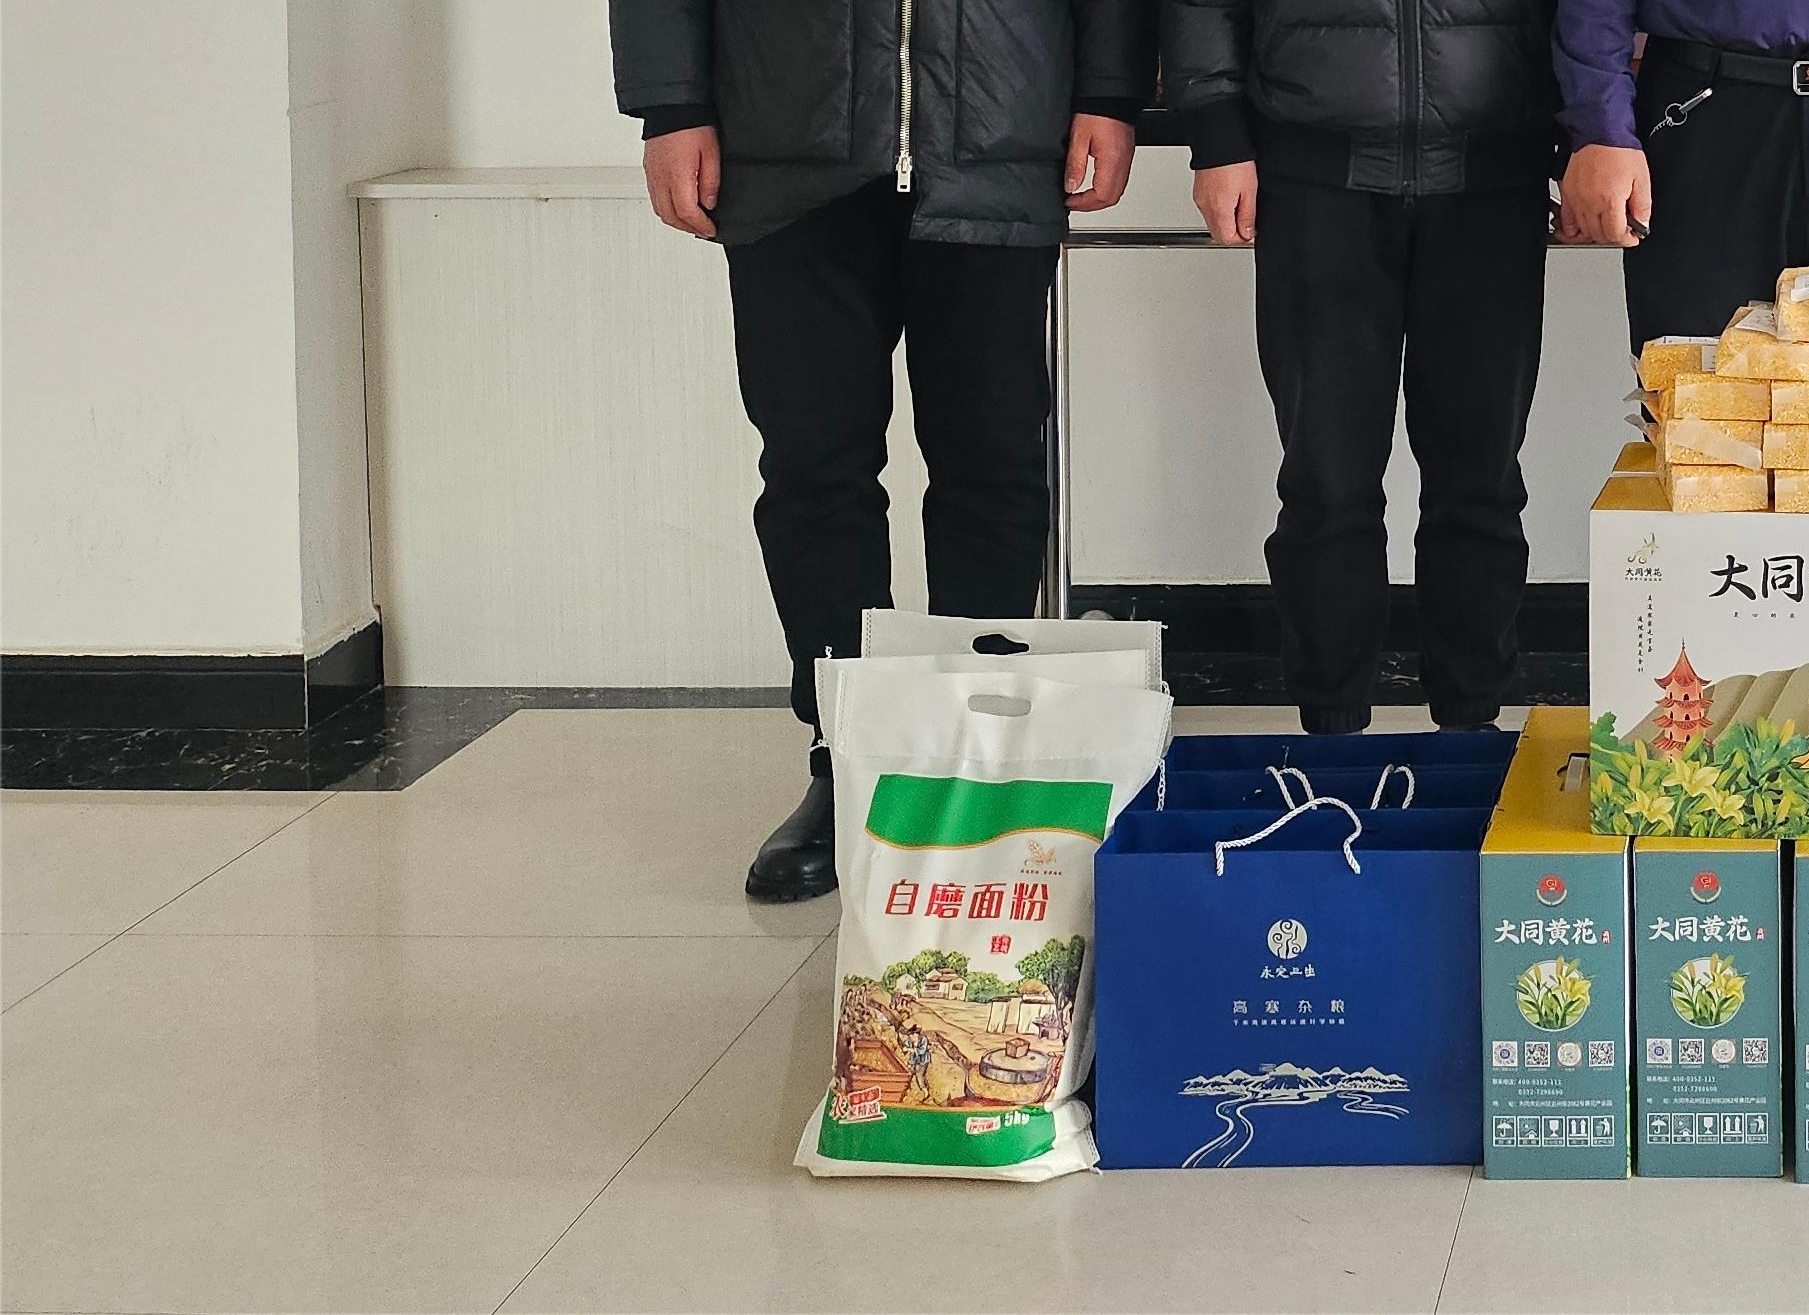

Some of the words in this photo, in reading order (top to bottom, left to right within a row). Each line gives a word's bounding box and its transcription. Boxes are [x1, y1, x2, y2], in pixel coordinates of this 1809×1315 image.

[884, 878, 1049, 922] 自磨面粉
[1494, 917, 1598, 945] 大同黄花
[1648, 914, 1752, 943] 大同黄花
[1232, 998, 1346, 1014] 高寒杂粮
